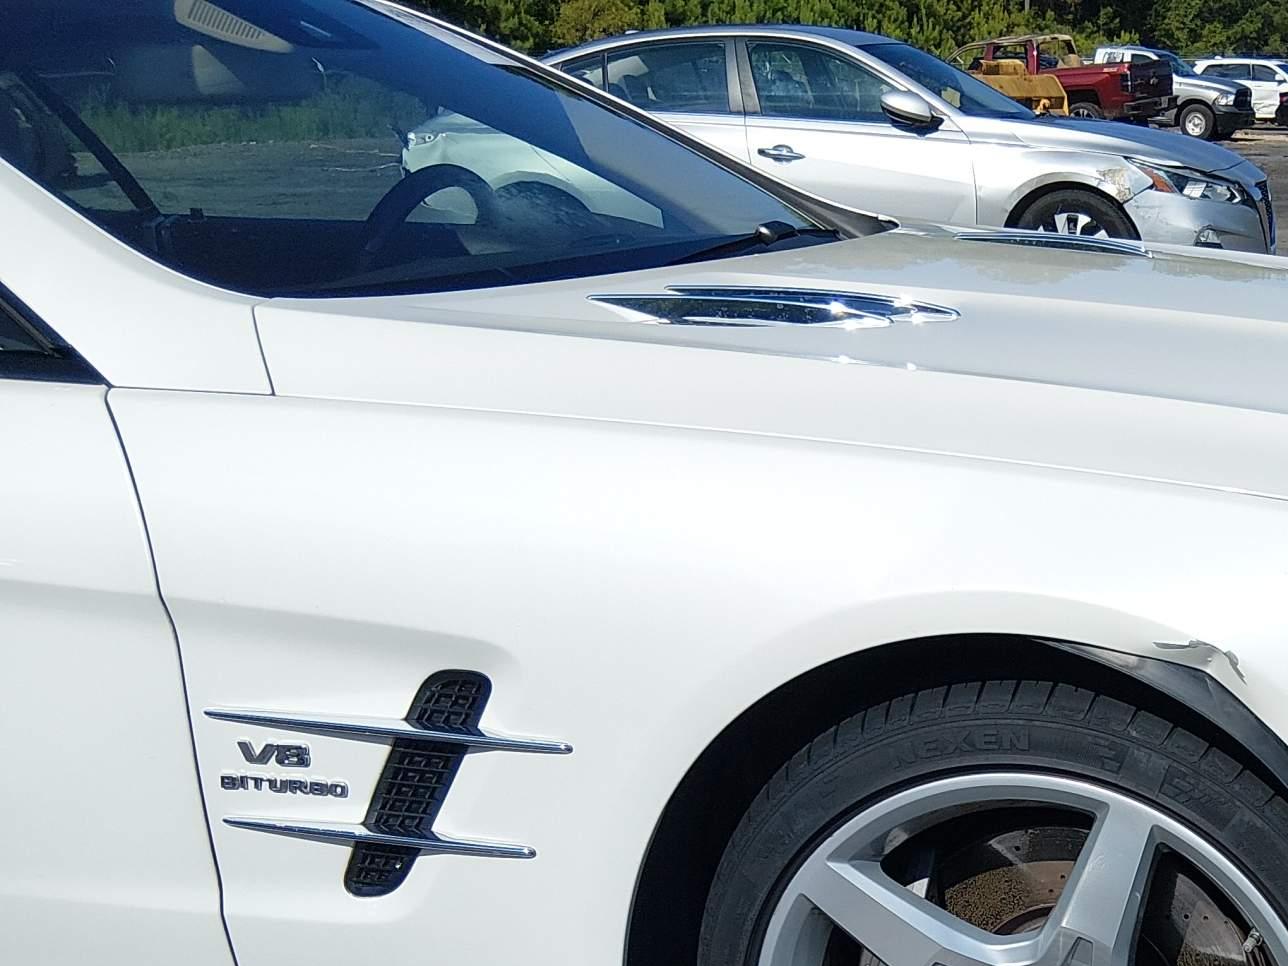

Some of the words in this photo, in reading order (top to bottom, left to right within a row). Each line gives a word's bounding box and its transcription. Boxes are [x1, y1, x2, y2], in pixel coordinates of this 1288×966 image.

[237, 740, 312, 769] V8
[893, 727, 1030, 769] NEXEN
[220, 774, 349, 799] BITURBO
